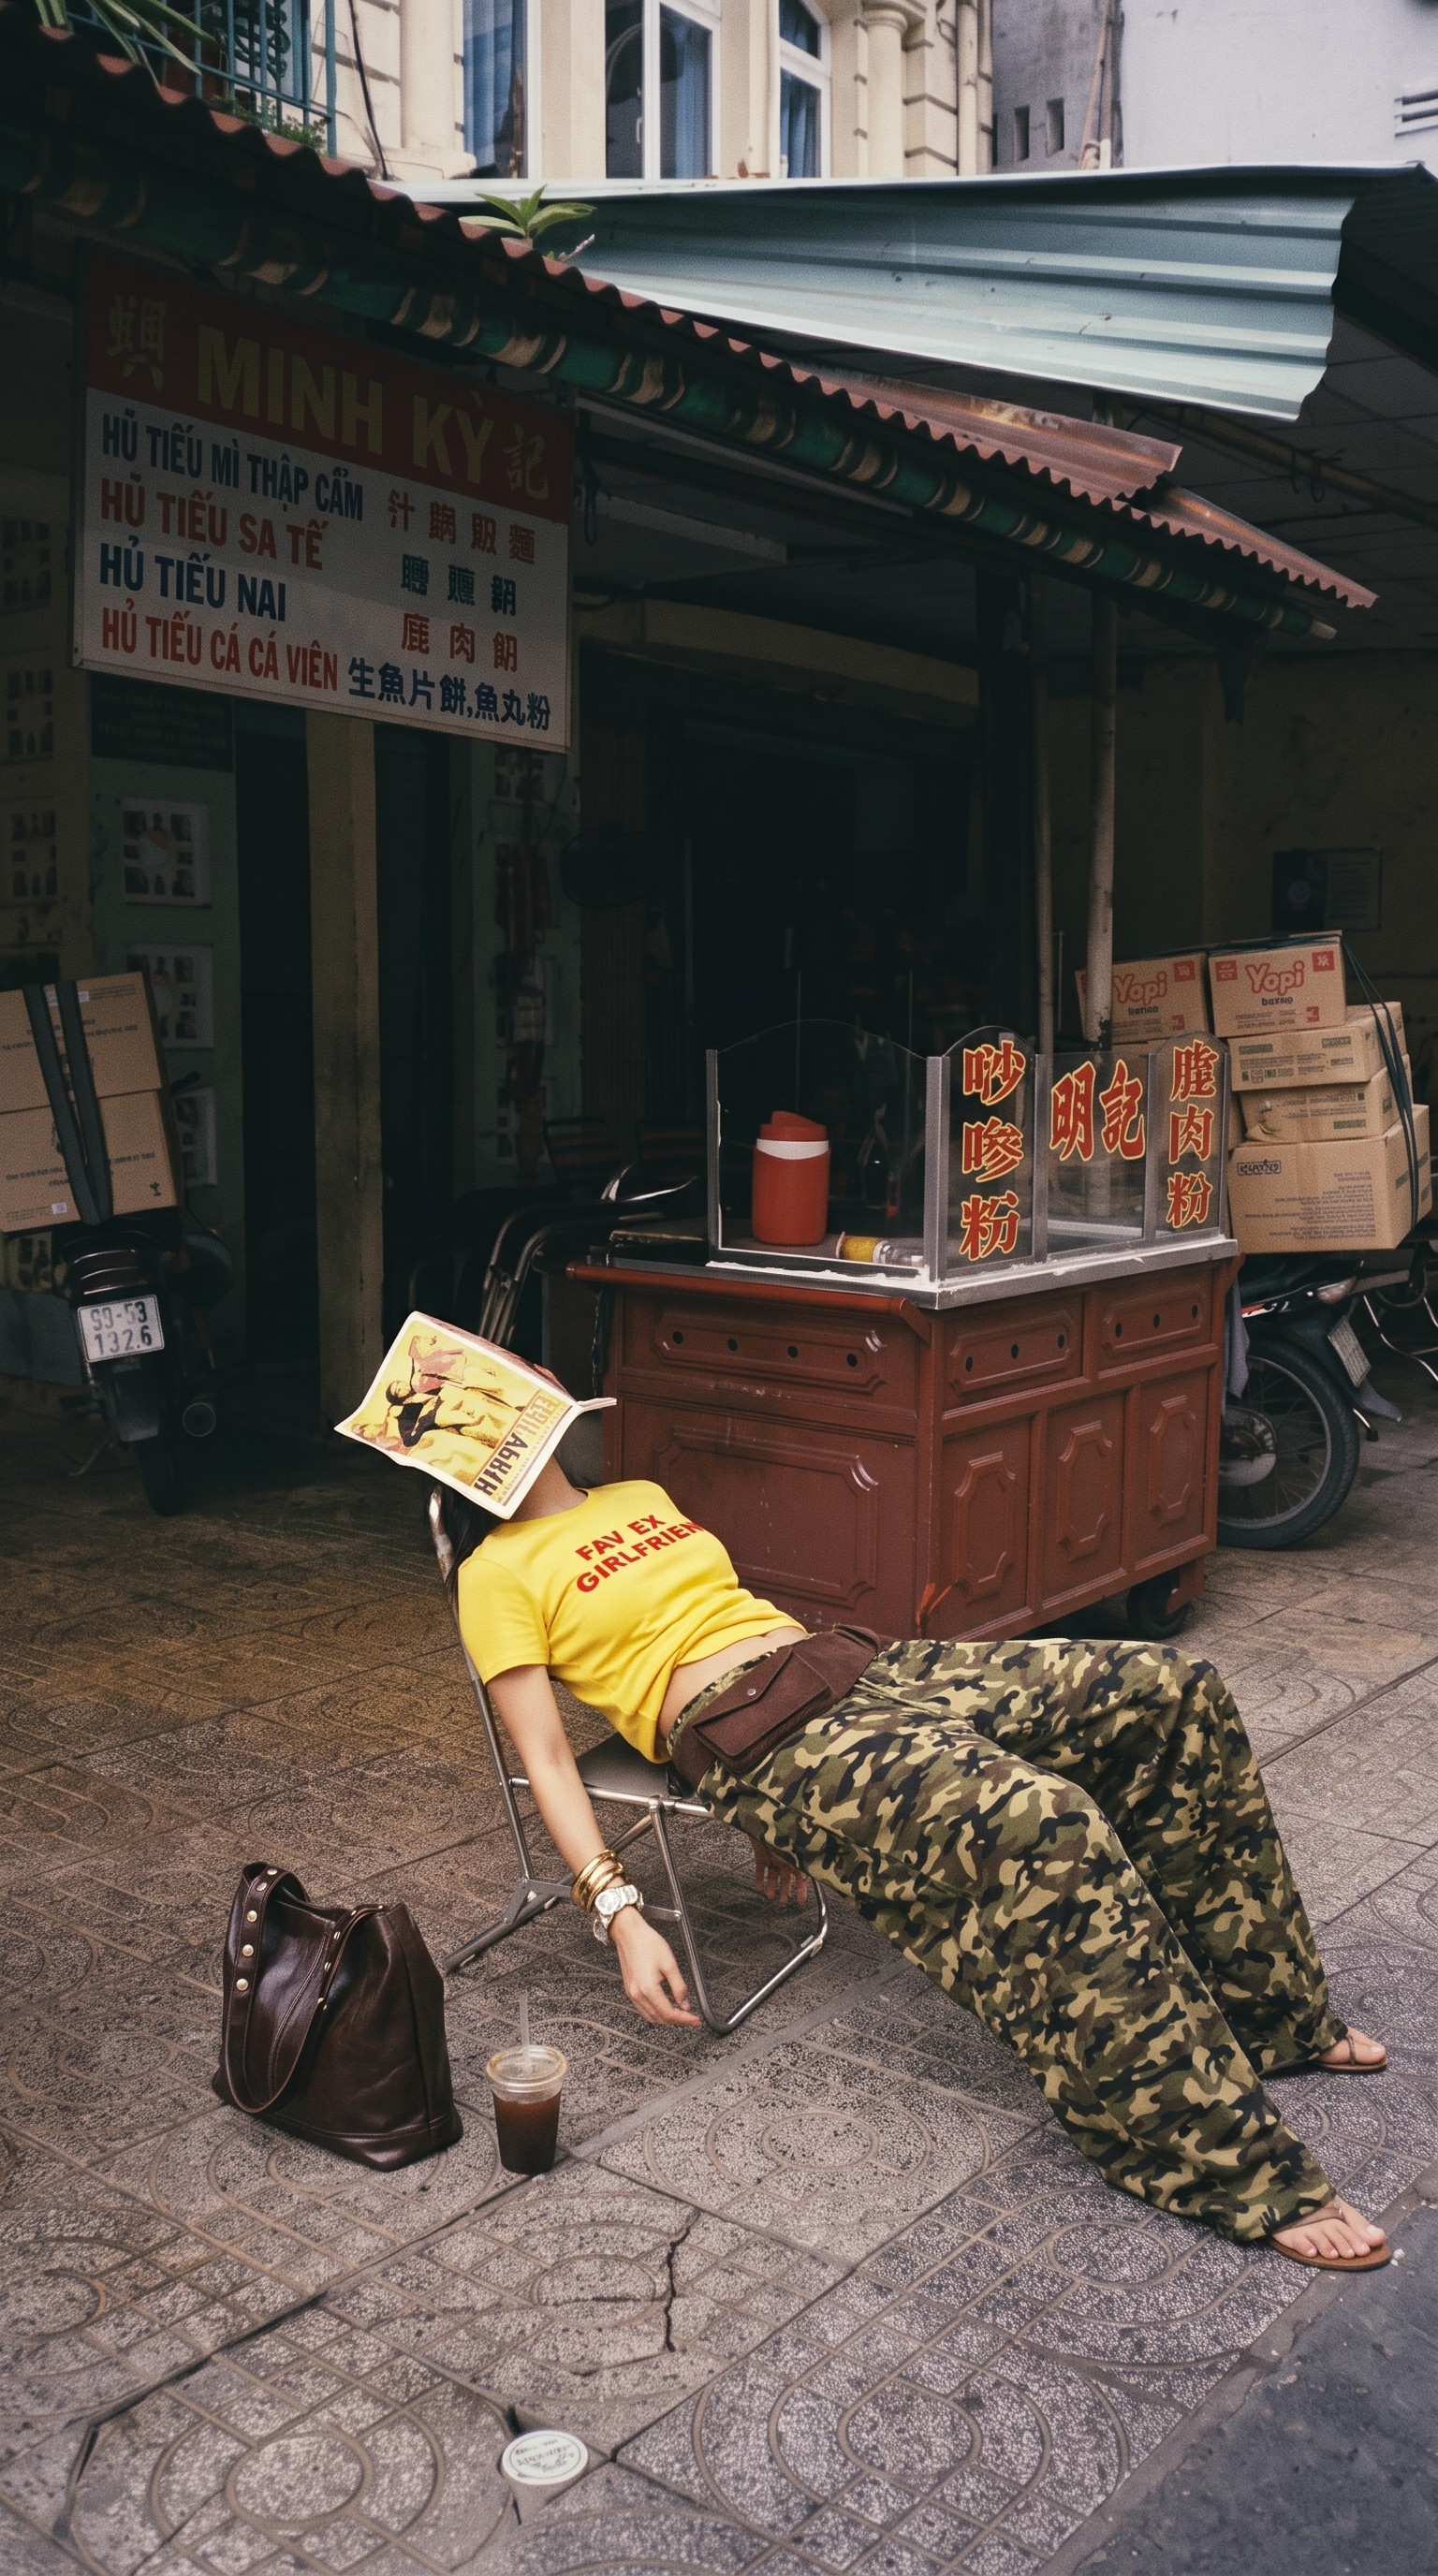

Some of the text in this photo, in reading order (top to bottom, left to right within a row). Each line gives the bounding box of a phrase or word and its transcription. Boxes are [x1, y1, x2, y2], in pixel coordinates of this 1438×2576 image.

[198, 325, 384, 455] MINH
[412, 389, 496, 485] KỲ
[146, 422, 202, 478] TIẾU
[212, 439, 239, 489] MÌ
[247, 453, 309, 511] THẬP
[156, 489, 227, 547] TIẾU
[239, 513, 277, 560] SA
[286, 520, 330, 570] TẾ
[99, 535, 286, 622] HỦ TIẾU NAI
[102, 597, 338, 692] HỦ TIẾU CÁ CÁ VIÊN
[1112, 971, 1168, 1006] Yopi
[1244, 960, 1305, 996] Yopi
[575, 1514, 667, 1561] FAV EX
